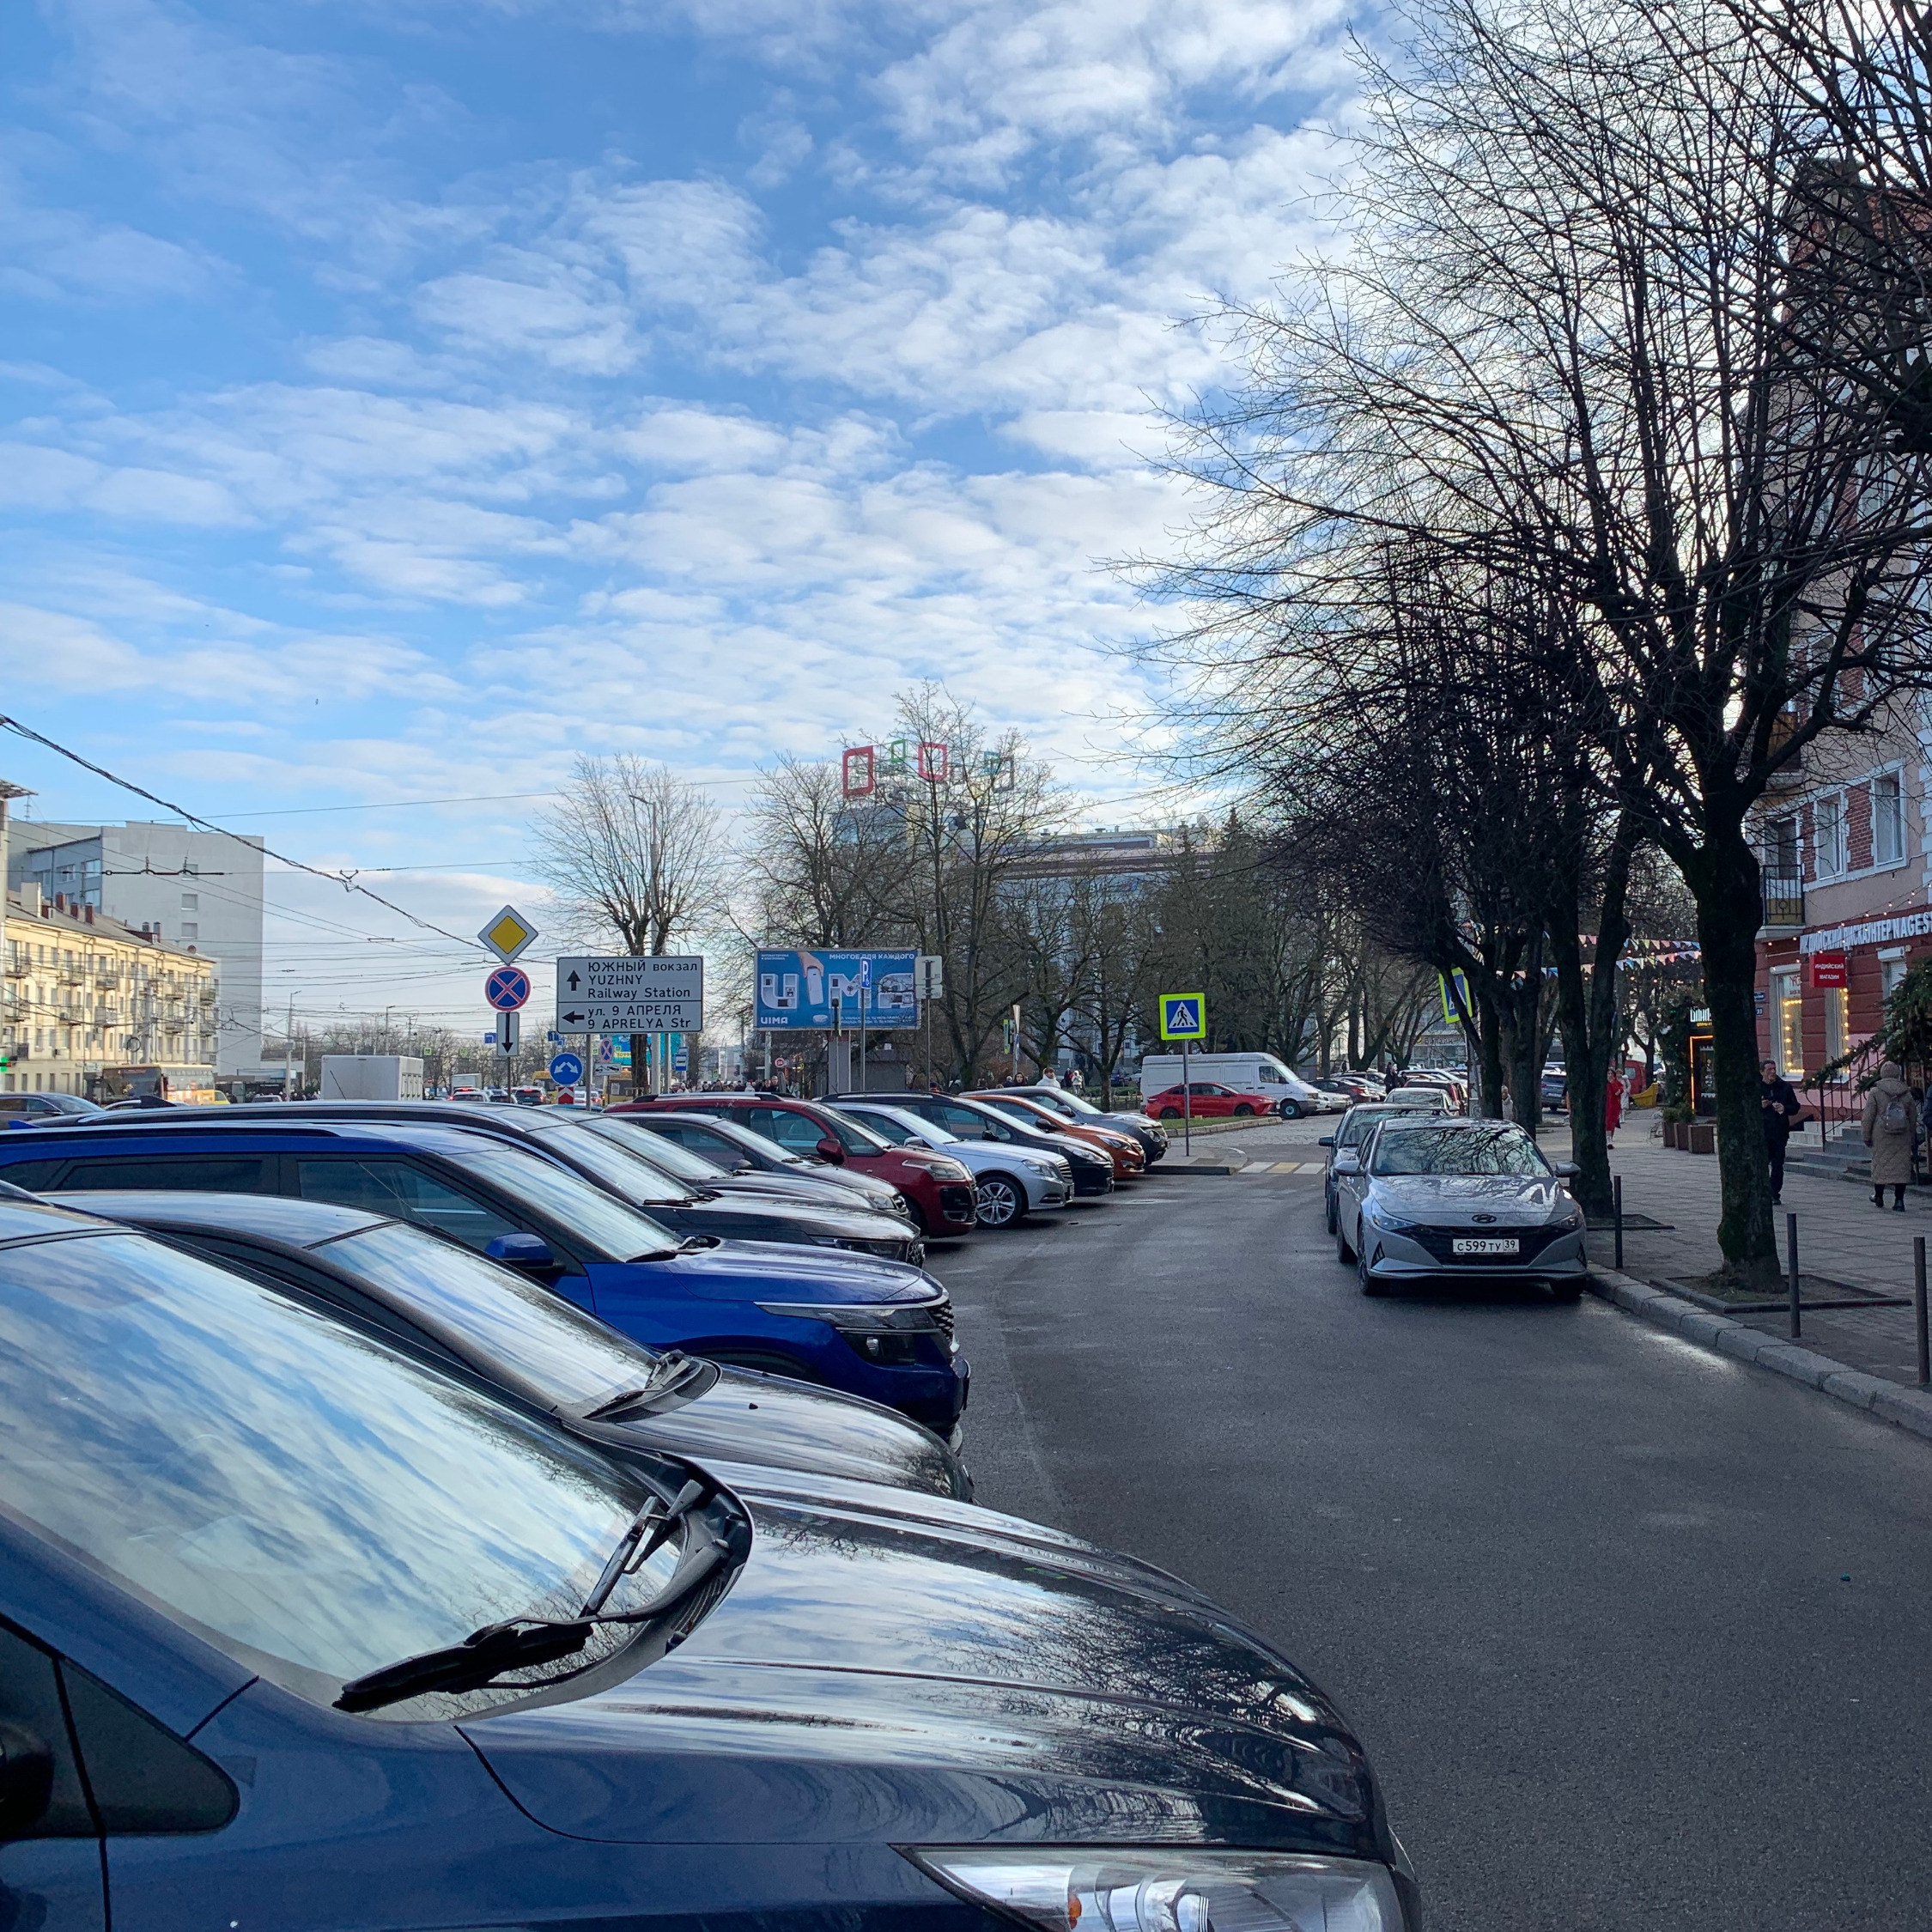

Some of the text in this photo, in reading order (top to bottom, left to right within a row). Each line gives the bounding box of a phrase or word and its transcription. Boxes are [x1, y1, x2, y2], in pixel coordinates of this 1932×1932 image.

[1892, 910, 1932, 939] NAGES
[587, 959, 698, 972] ЮЖНЫЙ вокзал
[1814, 962, 1844, 970] ИНДИЙСКИЙ
[588, 974, 643, 985] YUZHNY
[587, 987, 690, 1000] Railway Station
[587, 1005, 681, 1018] ул. 9 АПРЕЛЯ
[587, 1018, 691, 1030] 9 APRELYA Str
[1504, 1240, 1516, 1249] 39
